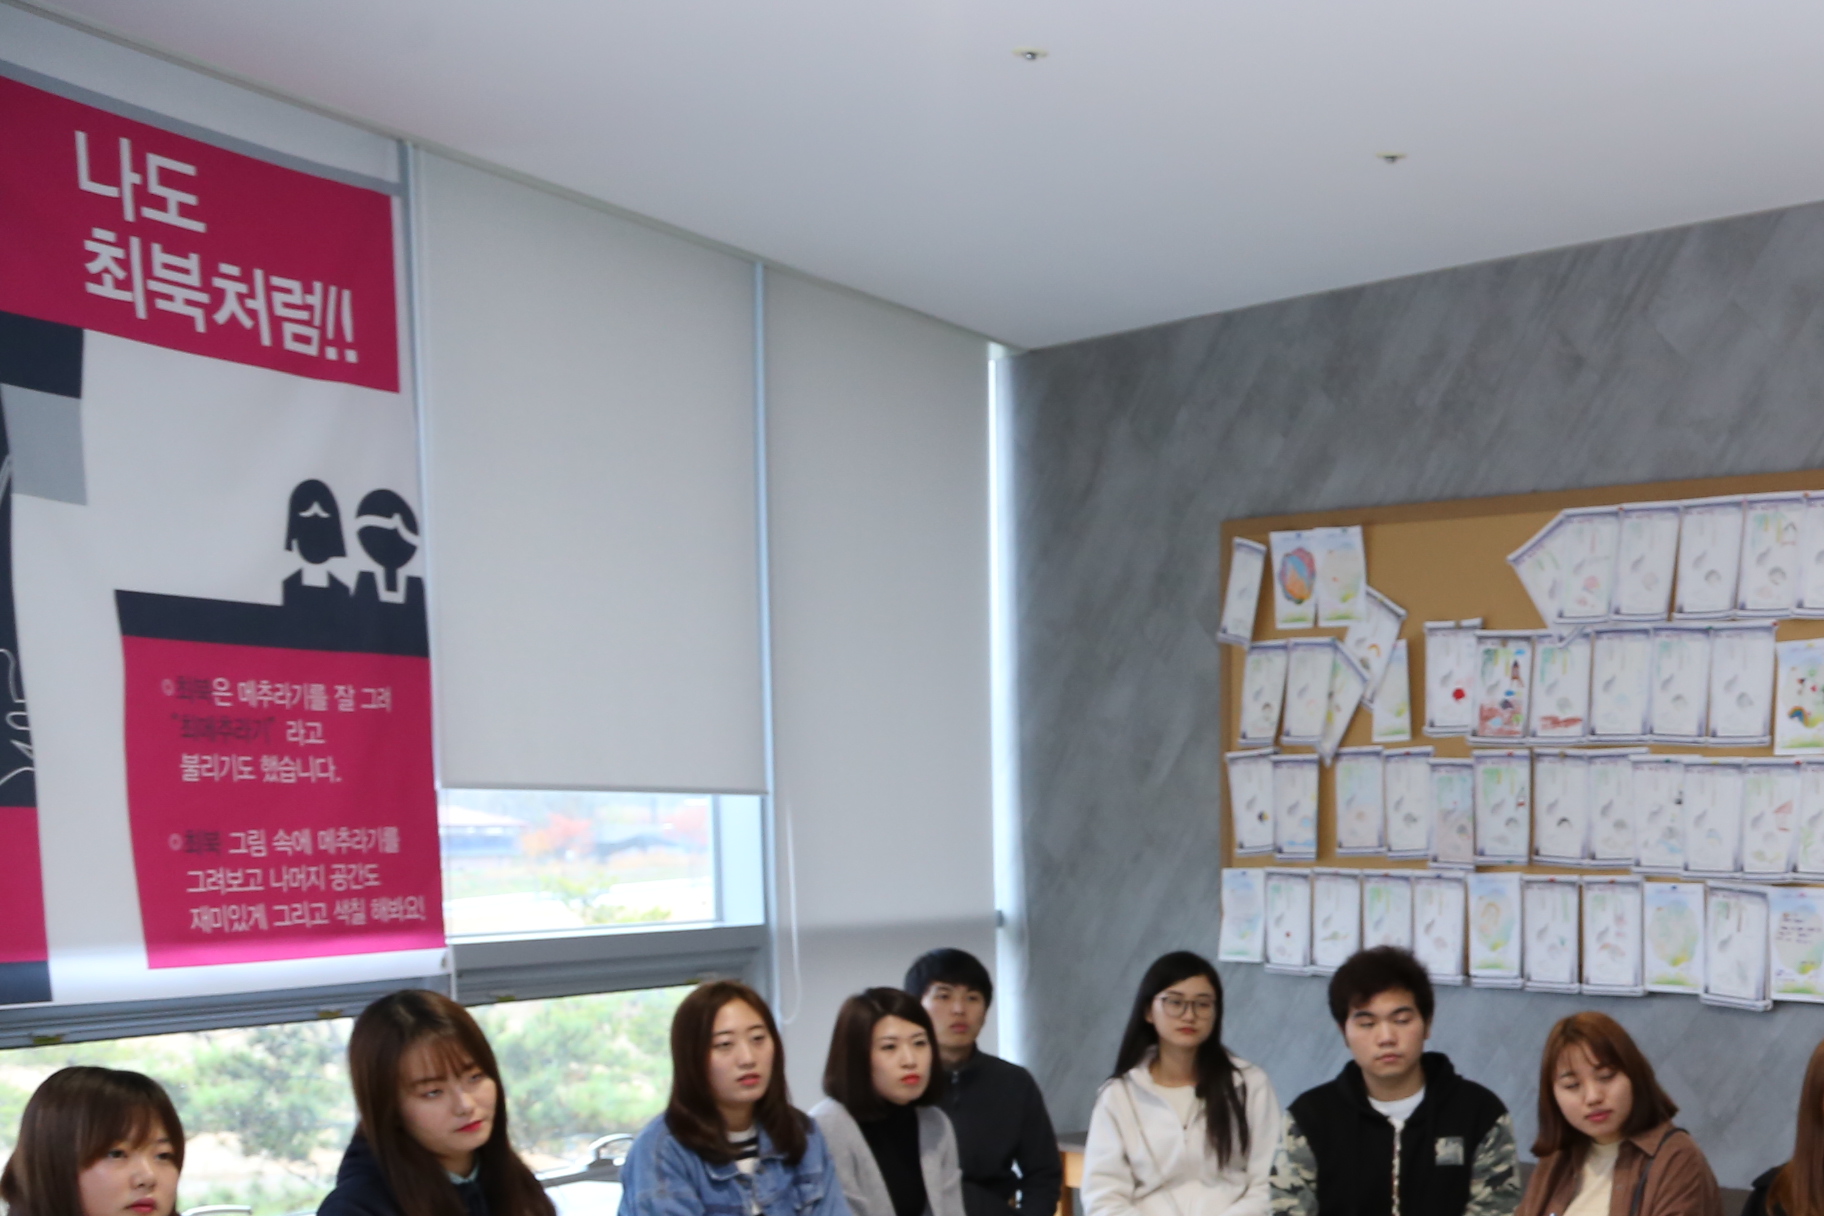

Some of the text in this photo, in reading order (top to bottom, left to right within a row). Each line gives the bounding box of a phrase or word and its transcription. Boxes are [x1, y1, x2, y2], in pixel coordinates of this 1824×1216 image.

[75, 130, 207, 233] 나도
[84, 226, 358, 363] 최북처럼!!
[333, 684, 355, 712] 잘
[286, 719, 326, 745] 라고
[180, 753, 256, 782] 불리기도
[228, 829, 267, 857] 그림
[271, 828, 312, 856] 속에
[186, 862, 381, 894] 그려보고 나머지 공간도
[189, 903, 268, 933] 재미있게
[272, 901, 330, 927] 그리고
